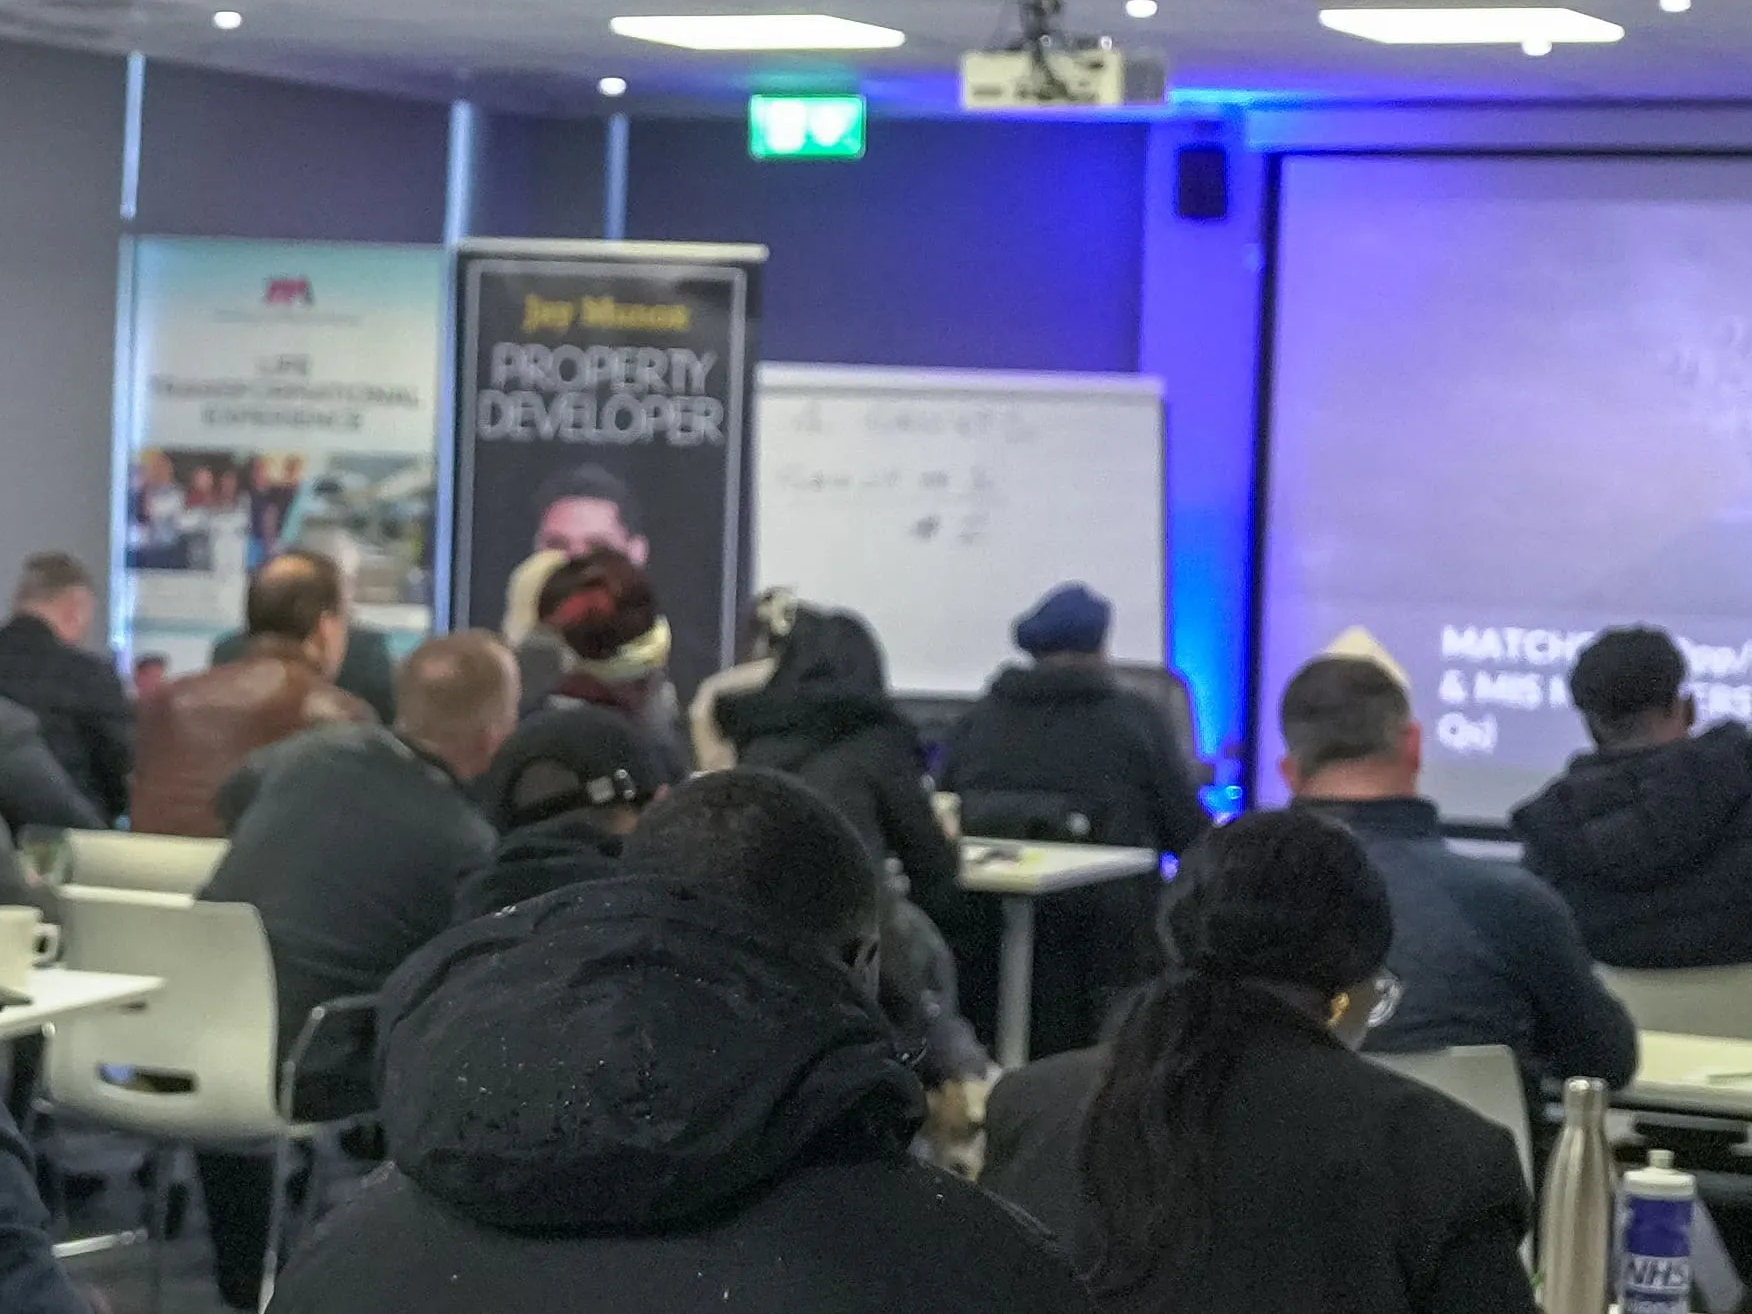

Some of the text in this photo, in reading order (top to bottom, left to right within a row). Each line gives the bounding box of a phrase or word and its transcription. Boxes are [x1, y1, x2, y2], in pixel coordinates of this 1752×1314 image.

[491, 341, 716, 396] PROPERTY
[476, 388, 725, 446] DEVELOPER
[1629, 1259, 1687, 1285] NHS
